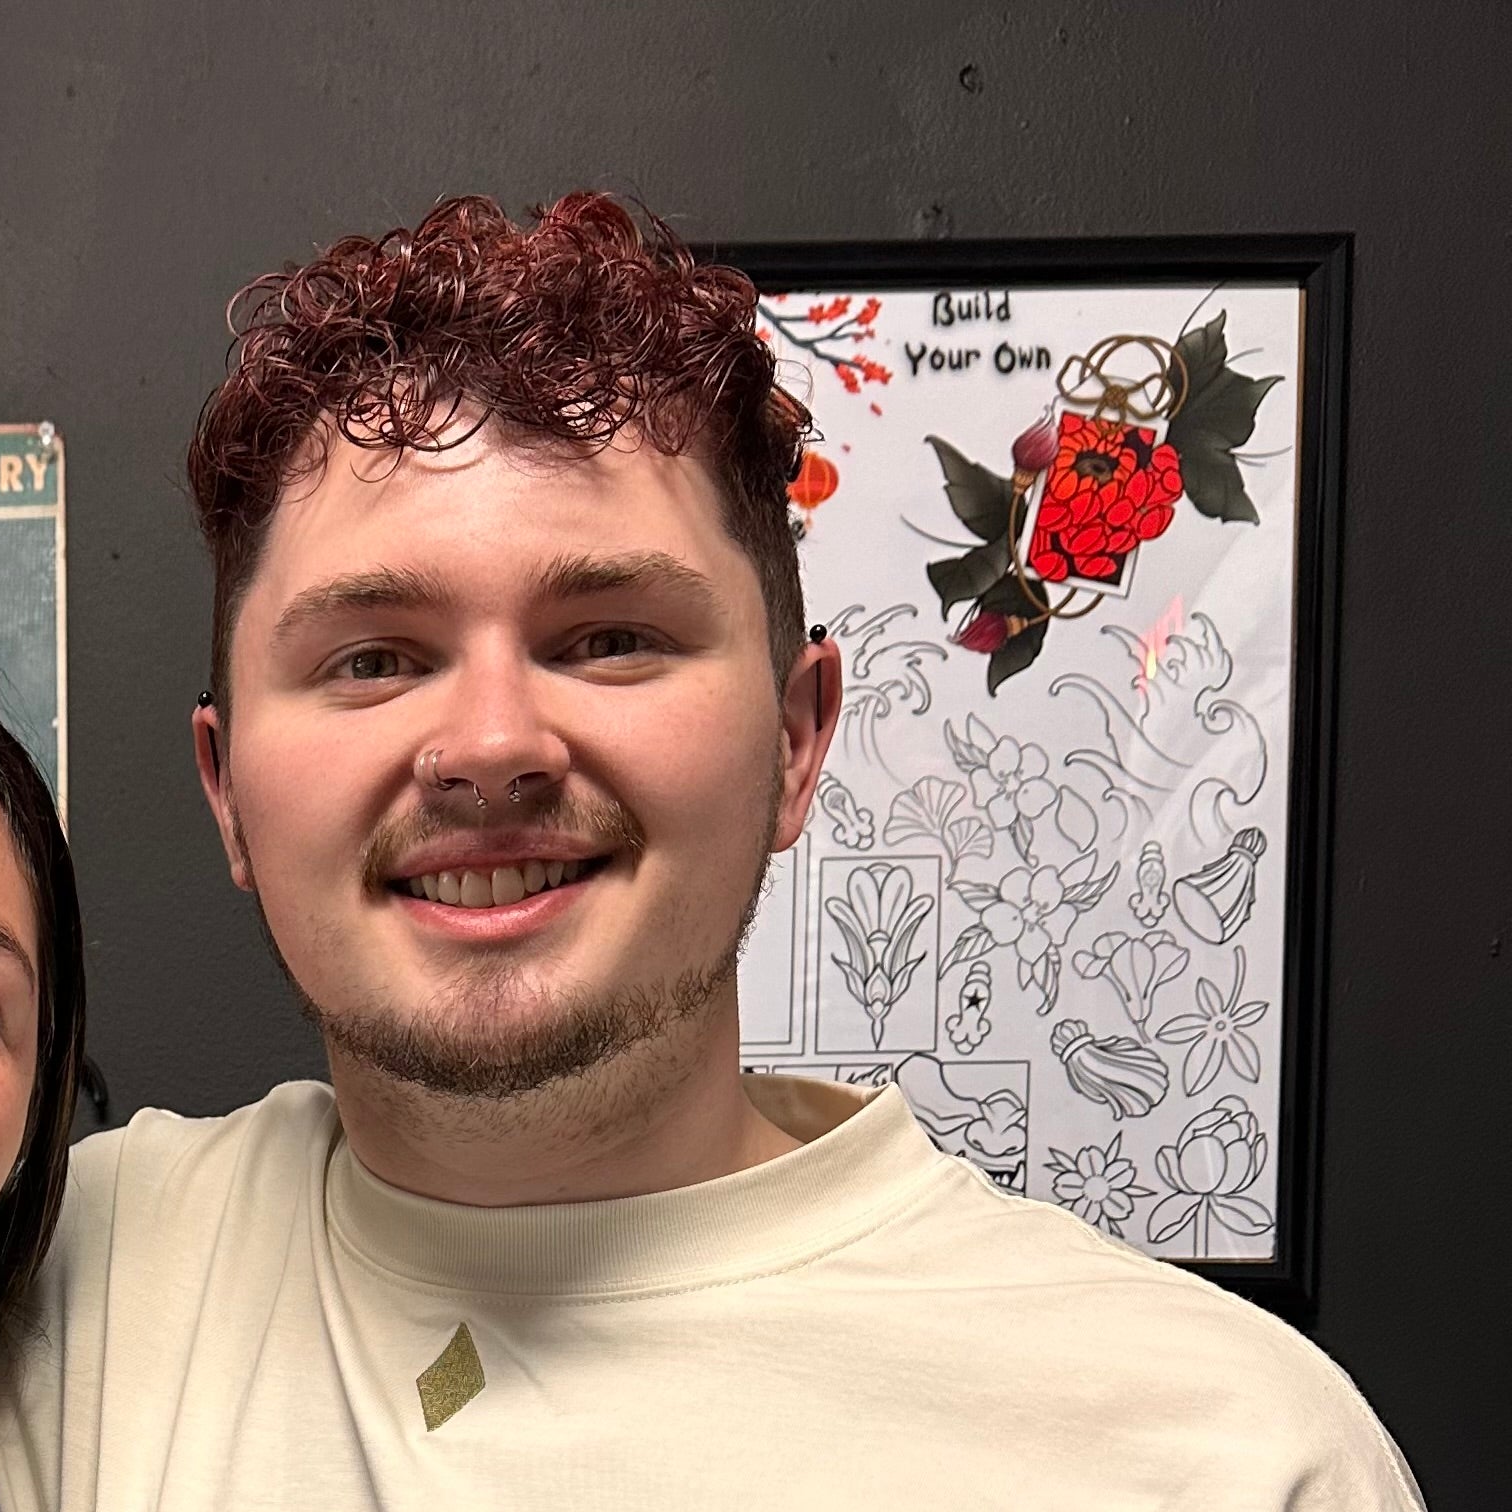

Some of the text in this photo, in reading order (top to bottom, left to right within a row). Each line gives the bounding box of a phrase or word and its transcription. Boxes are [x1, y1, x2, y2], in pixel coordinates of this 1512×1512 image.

[932, 288, 1011, 327] Build
[904, 340, 1051, 376] Your Own
